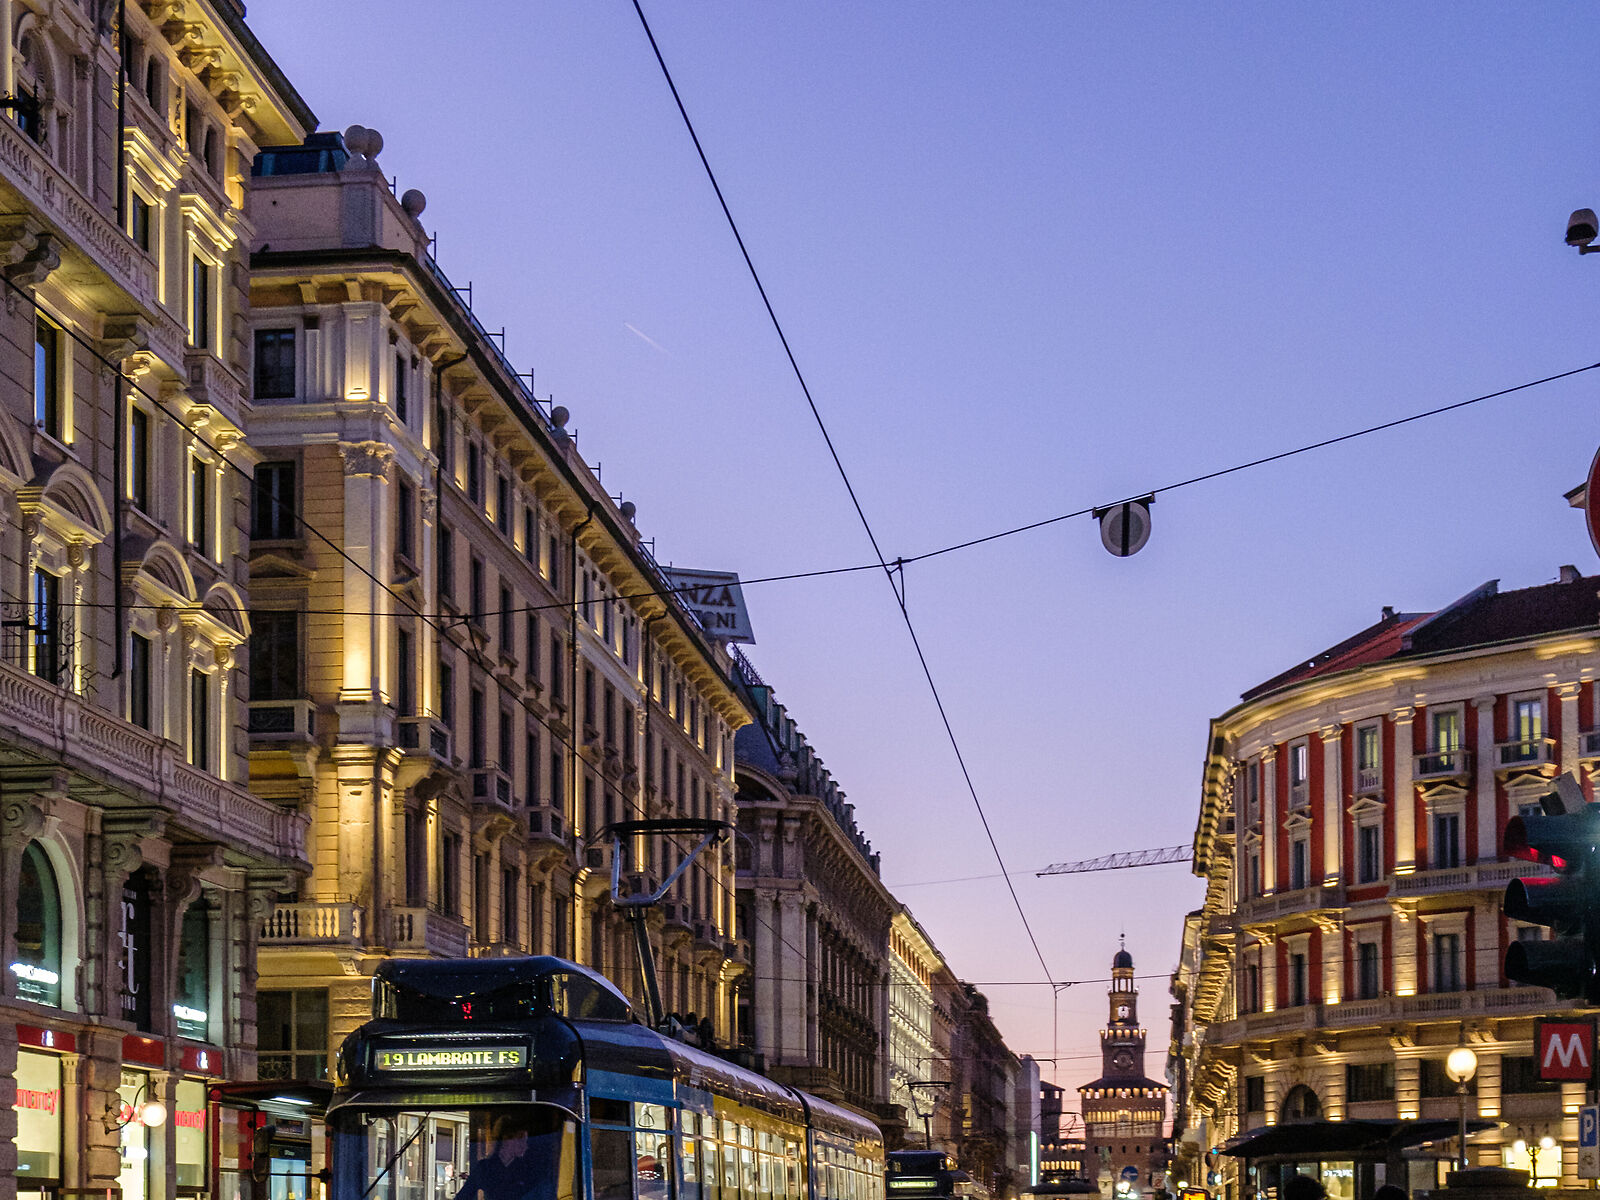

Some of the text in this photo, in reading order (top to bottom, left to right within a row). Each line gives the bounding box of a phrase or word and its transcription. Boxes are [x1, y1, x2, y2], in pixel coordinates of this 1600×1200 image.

[383, 1051, 520, 1066] 19 LAMBRATE FS
[1543, 1033, 1589, 1068] M
[1583, 1114, 1594, 1142] P
